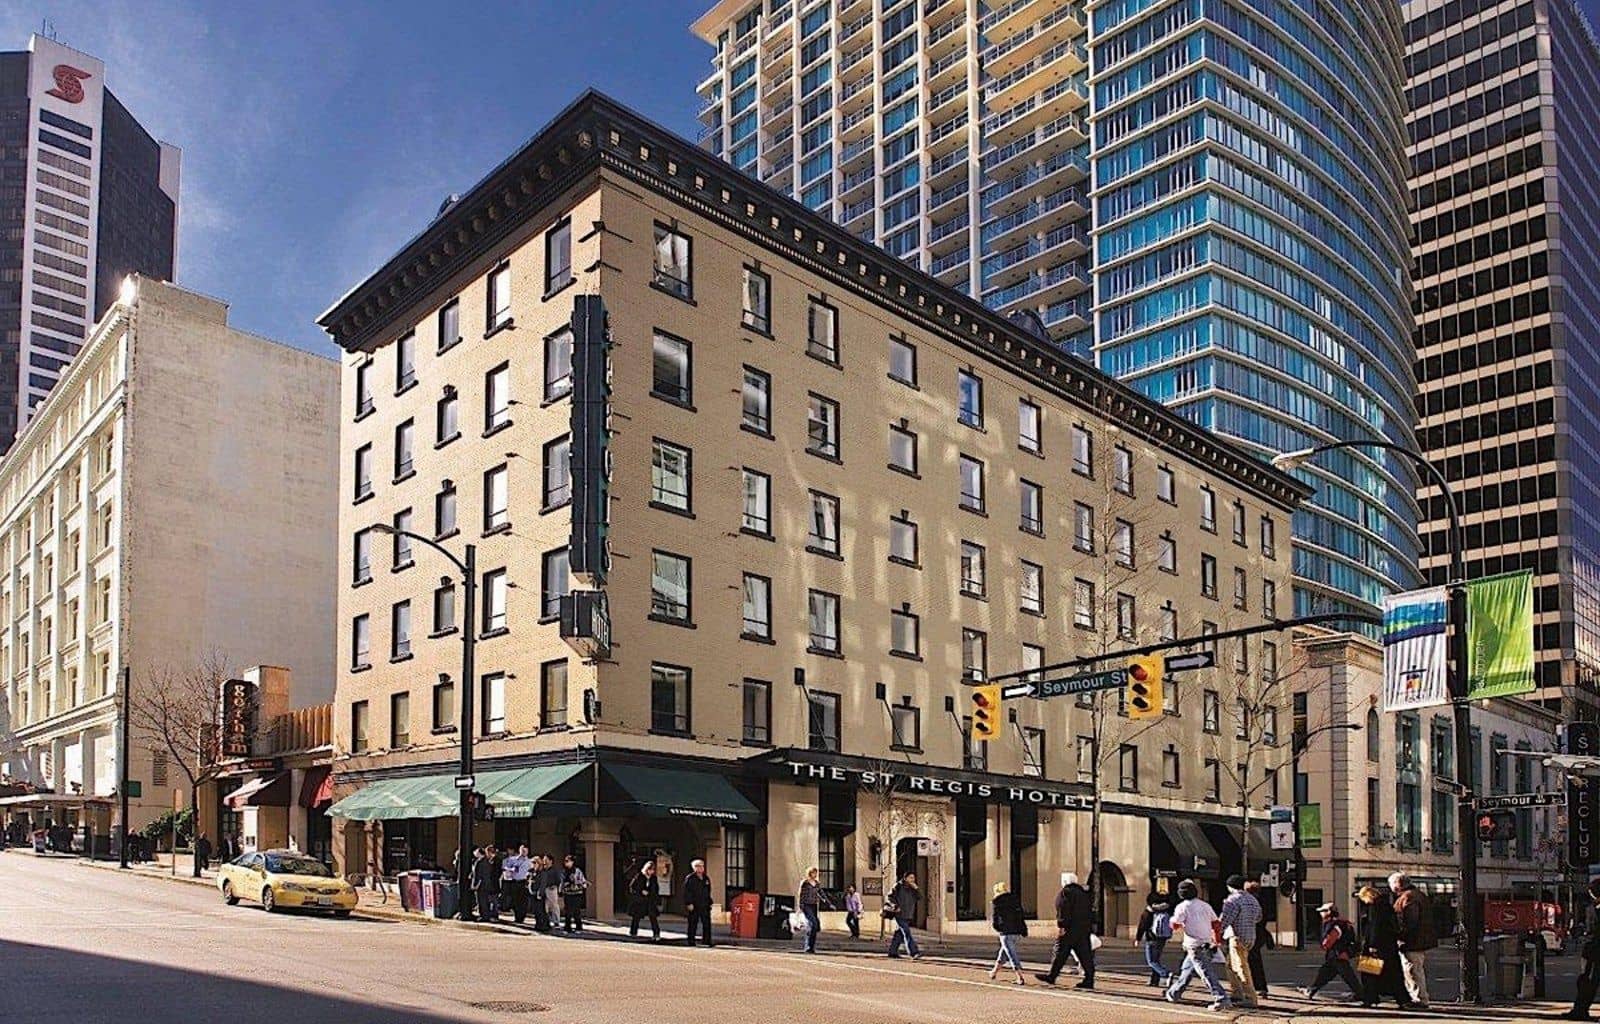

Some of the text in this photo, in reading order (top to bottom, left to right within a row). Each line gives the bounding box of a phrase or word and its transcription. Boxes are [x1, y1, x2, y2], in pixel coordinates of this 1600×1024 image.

[1043, 671, 1127, 694] Seymour St
[788, 761, 1095, 809] THE ST REGIS HOTEL
